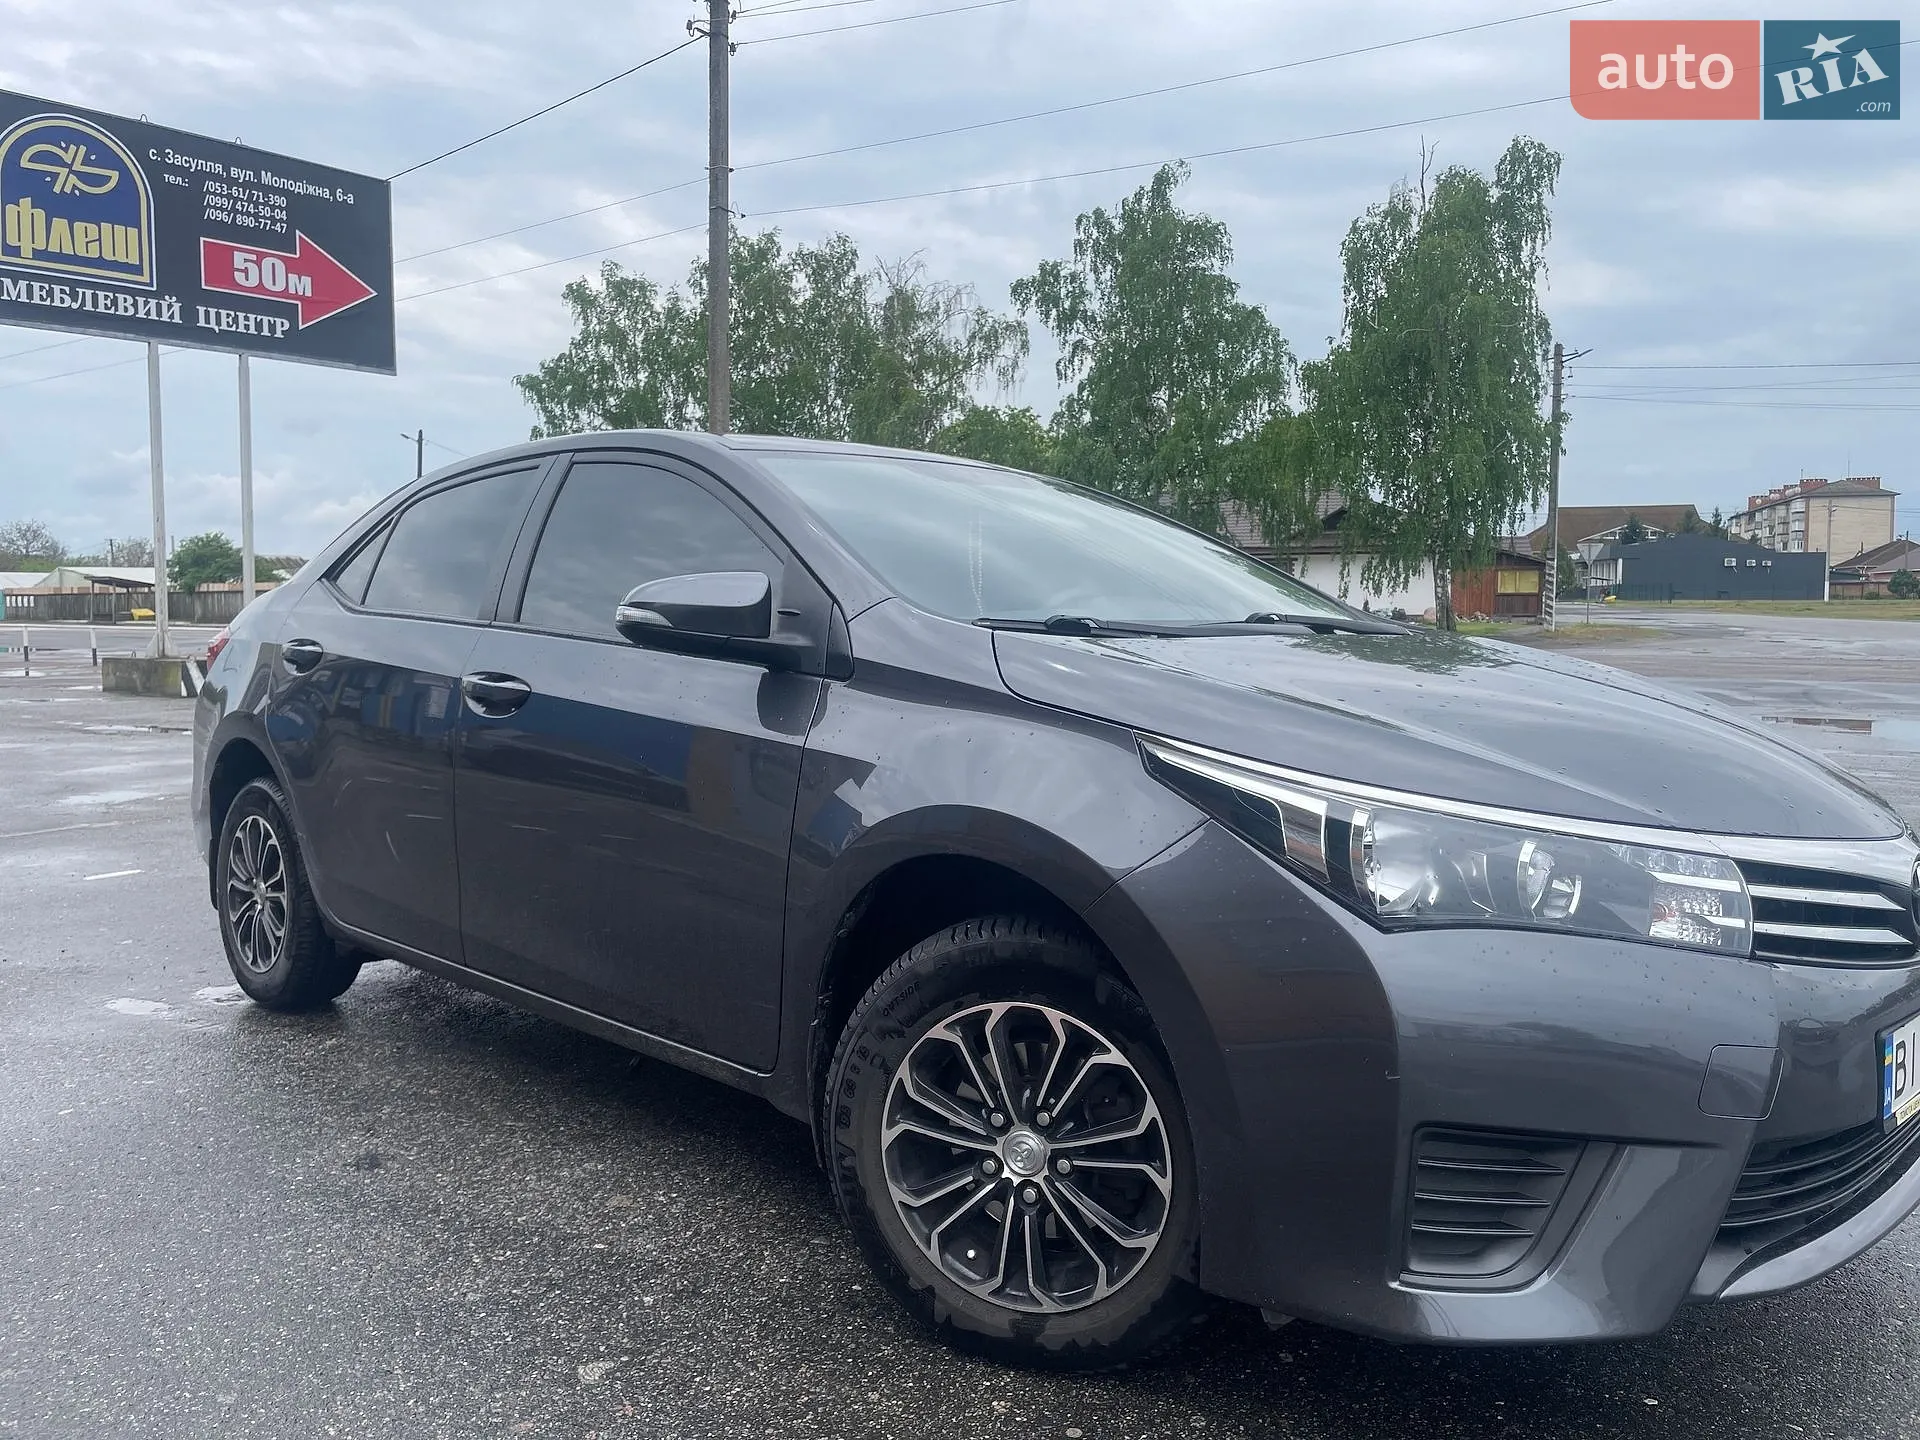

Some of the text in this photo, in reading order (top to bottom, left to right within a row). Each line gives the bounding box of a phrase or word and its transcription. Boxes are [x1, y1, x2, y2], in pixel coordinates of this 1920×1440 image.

[149, 149, 354, 205] с. Засулля, вул. Молодіжна, 6-а
[163, 173, 189, 187] тел.:
[203, 180, 287, 208] /053-61/ 71-390
[203, 194, 288, 221] /099/ 474-50-04
[203, 208, 288, 234] /096/ 890-77-47
[0, 277, 290, 339] МЕБЛЕВИЙ ЦЕНТР
